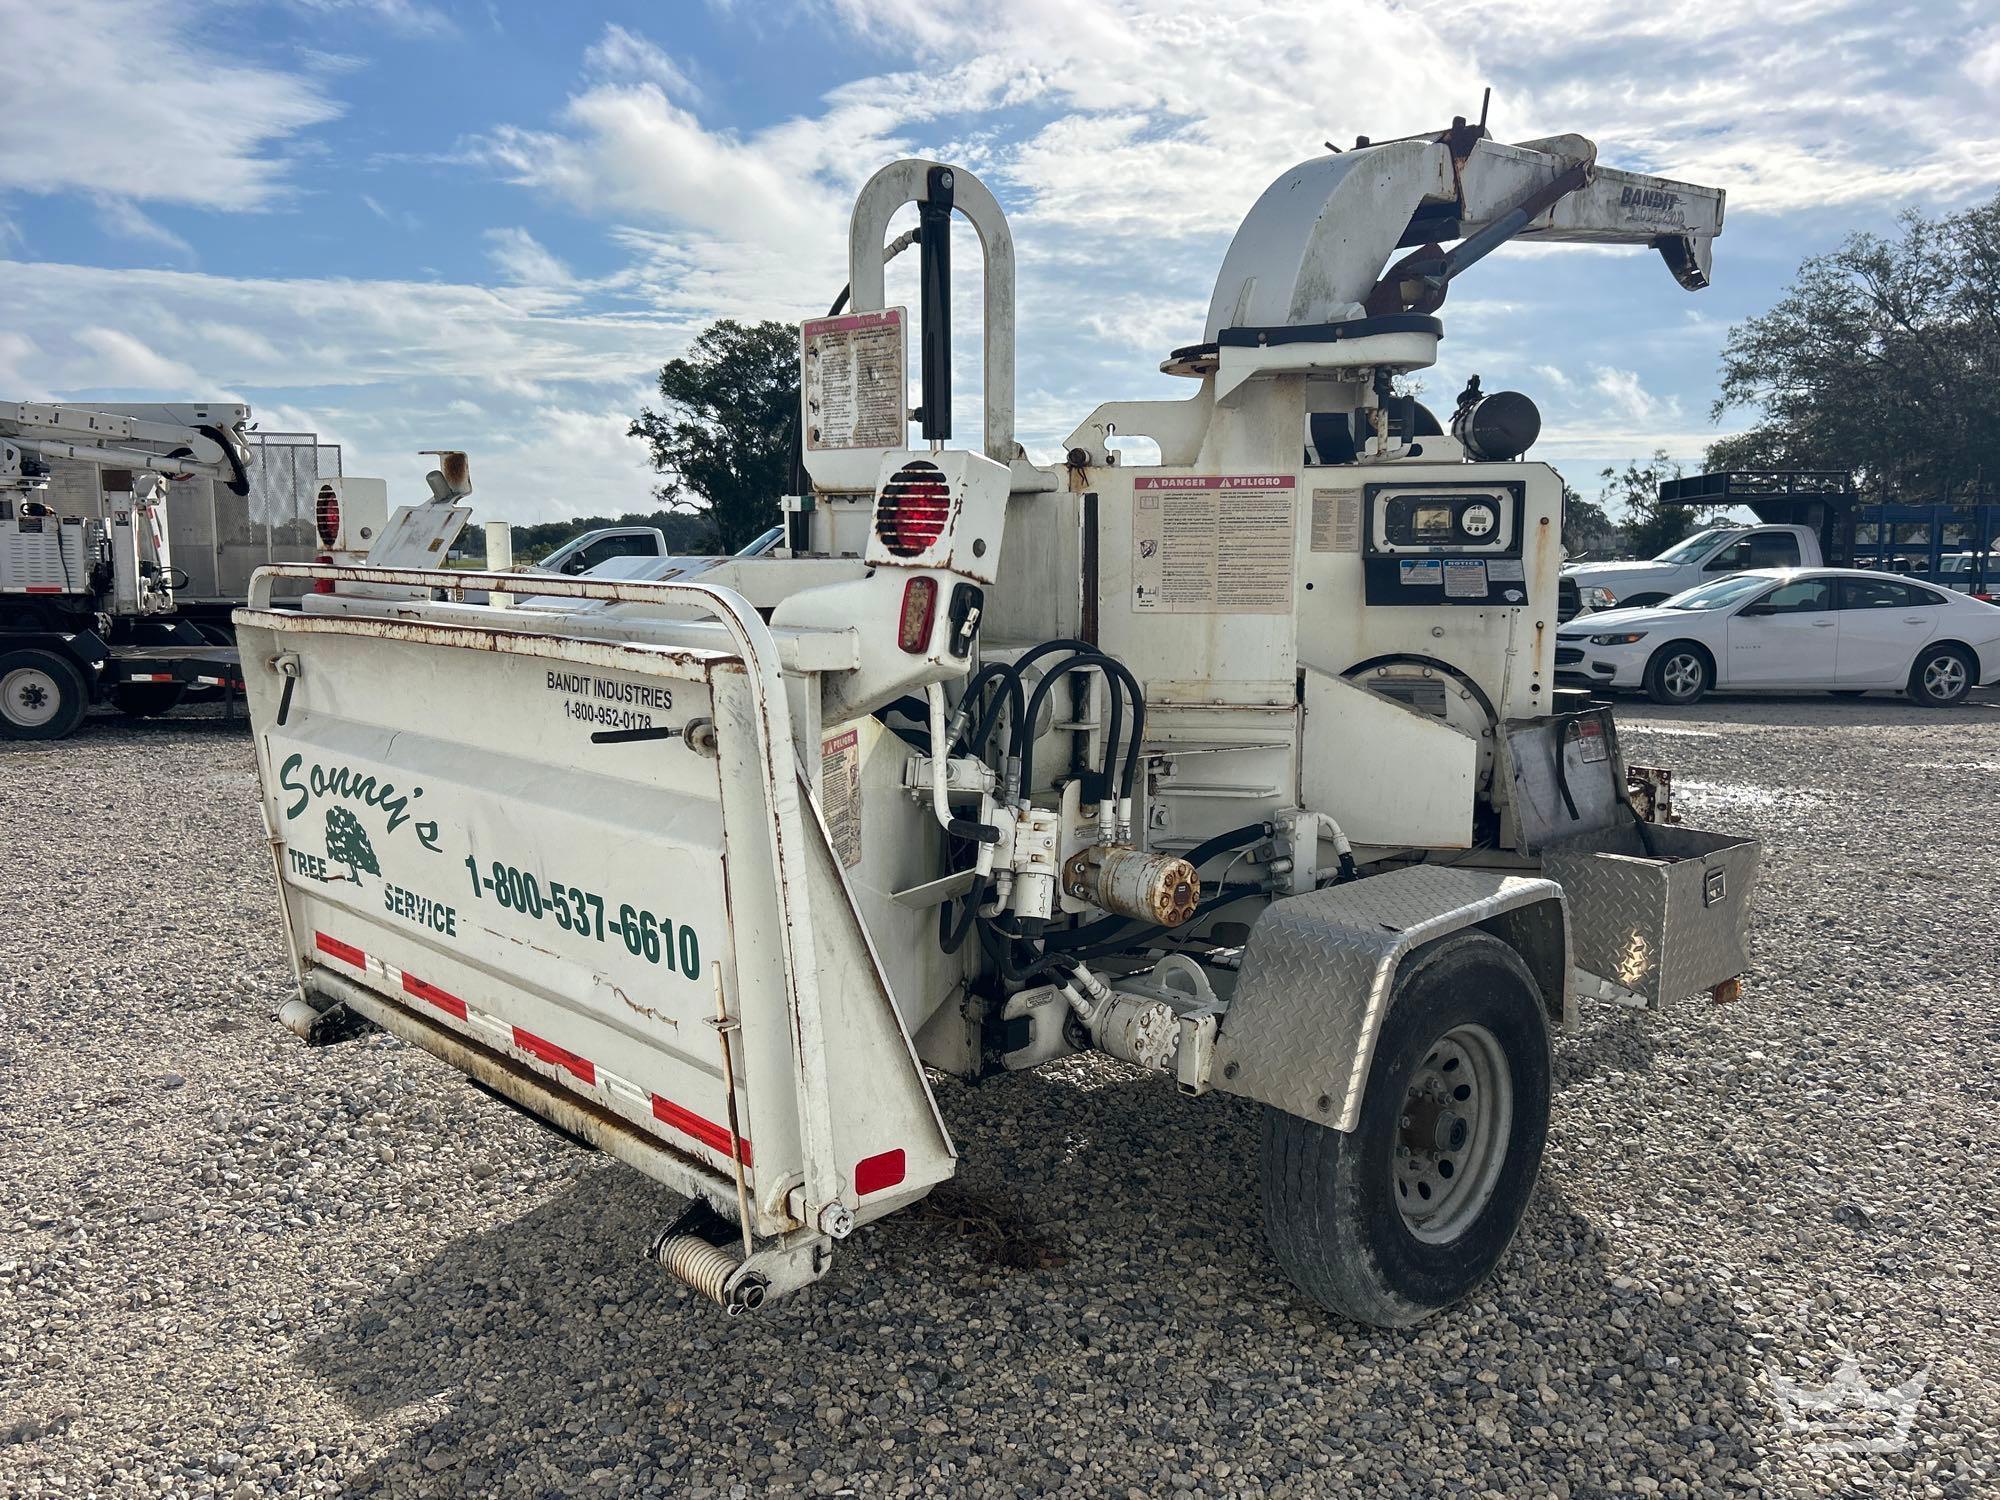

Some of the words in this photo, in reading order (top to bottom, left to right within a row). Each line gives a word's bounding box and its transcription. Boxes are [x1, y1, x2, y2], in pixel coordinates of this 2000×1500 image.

[1620, 186, 1682, 211] BANDIT
[1161, 478, 1206, 488] DANGER
[1233, 477, 1281, 487] PELIGRO
[547, 671, 591, 695] BANDIT
[594, 678, 673, 710] INDUSTRIES
[563, 700, 652, 730] 1-800-952-0178
[279, 753, 443, 854] Sonny's
[288, 847, 329, 884] TREE
[384, 881, 457, 938] SERVICE
[465, 854, 701, 981] 1-800-537-6610
